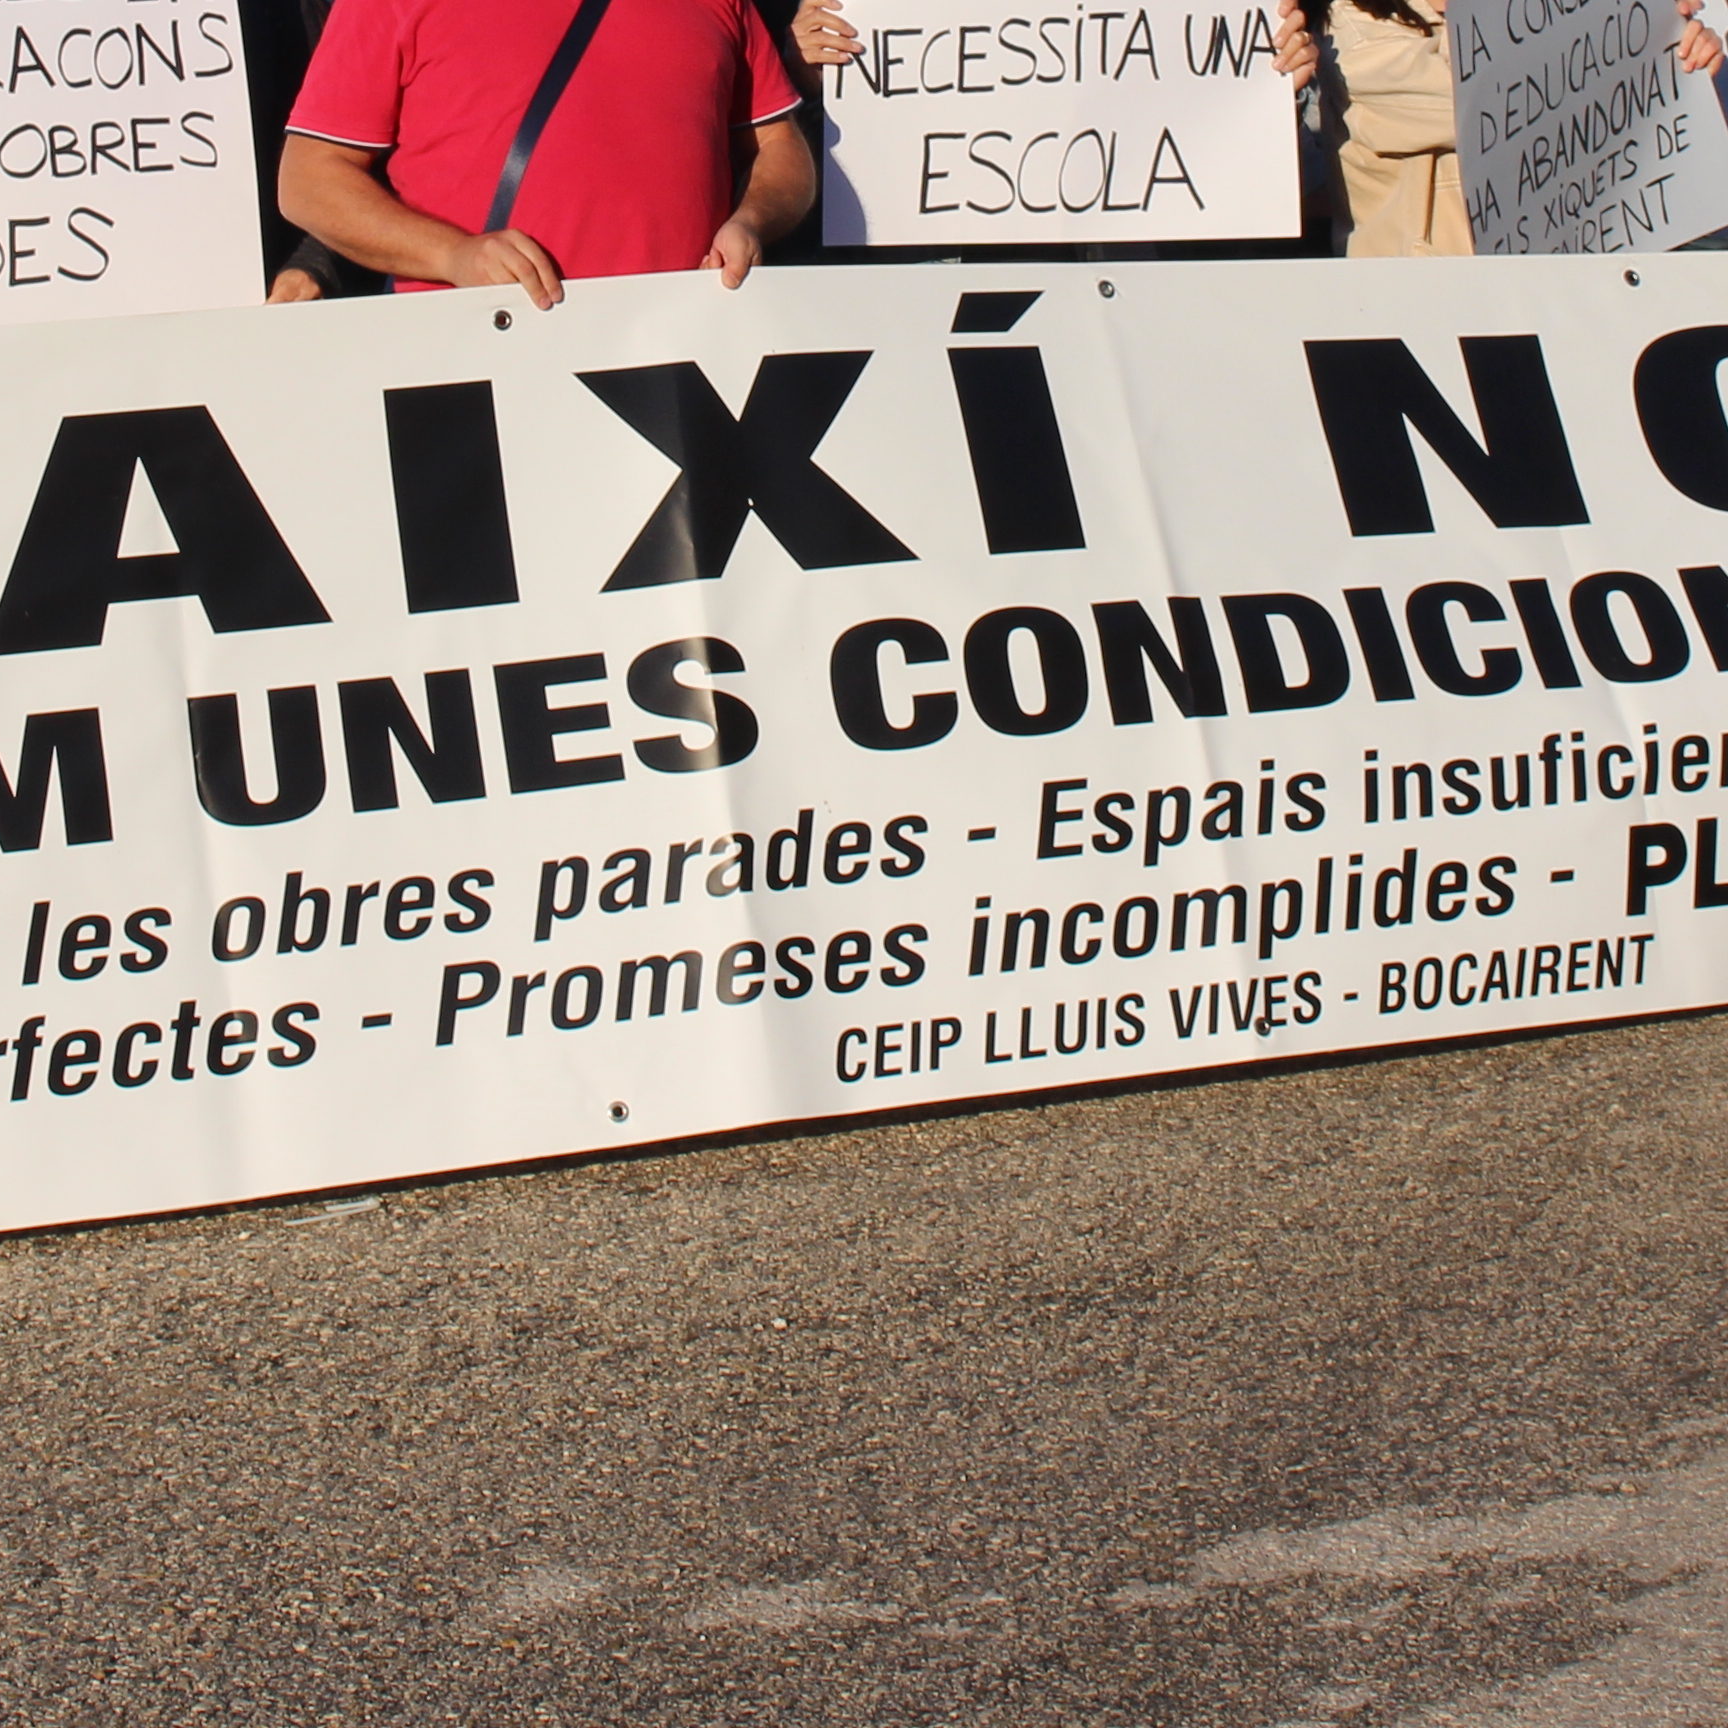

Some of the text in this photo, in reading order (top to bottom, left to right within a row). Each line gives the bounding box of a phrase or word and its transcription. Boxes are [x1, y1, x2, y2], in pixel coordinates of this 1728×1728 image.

[1185, 7, 1286, 79] UNA
[1456, 14, 1492, 84] LA
[919, 127, 1206, 215] ESCOLA
[1466, 40, 1682, 247] HA ABANDONAT
[1656, 114, 1692, 161] DE
[187, 637, 758, 826] UNES
[22, 901, 171, 985] les
[212, 869, 494, 962] obres
[534, 809, 928, 941] parades
[1037, 759, 1326, 867] Espais
[436, 924, 928, 1047] Promeses
[968, 844, 1517, 979] incomplides
[837, 1017, 961, 1083] CEIP
[985, 993, 1145, 1063] LLUIS
[1169, 971, 1321, 1038] VIVES
[1380, 934, 1654, 1014] BOCAIRENT
